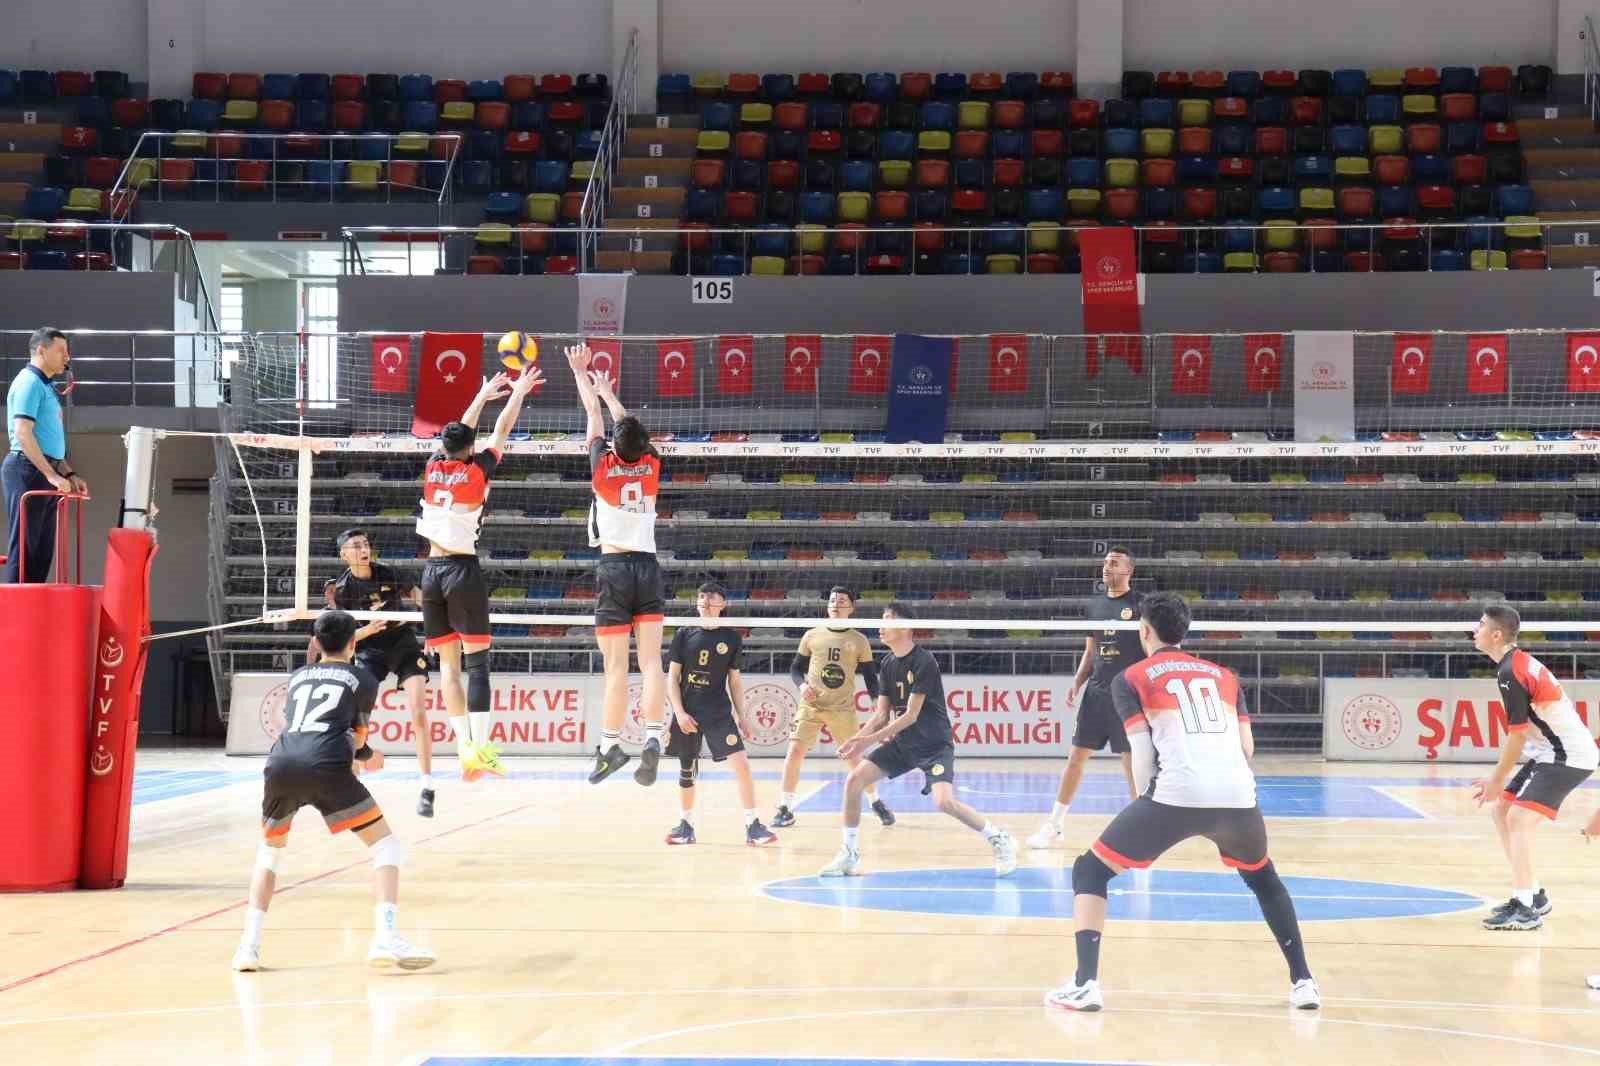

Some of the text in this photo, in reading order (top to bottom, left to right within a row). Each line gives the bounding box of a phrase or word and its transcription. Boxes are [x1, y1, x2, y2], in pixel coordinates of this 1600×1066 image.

[693, 281, 732, 300] 105
[335, 441, 350, 449] TVF
[376, 441, 392, 449] TVF
[416, 442, 433, 450] TVF
[742, 446, 759, 454] TVF
[783, 446, 799, 454] TVF
[824, 446, 841, 454] TVF
[864, 446, 881, 454] TVF
[906, 446, 922, 454] TVF
[946, 446, 963, 454] TVF
[987, 447, 1004, 455] TVF
[1029, 447, 1045, 455] TVF
[1070, 447, 1088, 455] TVF
[1111, 447, 1128, 455] TVF
[1153, 447, 1170, 455] TVF
[1195, 447, 1212, 455] TVF
[1363, 446, 1381, 454] TVF
[1406, 446, 1423, 454] TVF
[1449, 445, 1467, 453] TVF
[1493, 445, 1510, 453] TVF
[1536, 444, 1554, 452] TVF
[1580, 443, 1598, 451] TVF
[1095, 541, 1105, 555] D
[698, 649, 709, 666] 8
[827, 647, 841, 662] 16
[543, 689, 578, 711] VE
[895, 681, 904, 700] 7
[97, 674, 115, 737] TVF
[288, 683, 345, 733] 12
[946, 686, 1010, 718] ÇLİK
[1016, 690, 1052, 712] VE
[1164, 678, 1227, 734] 10
